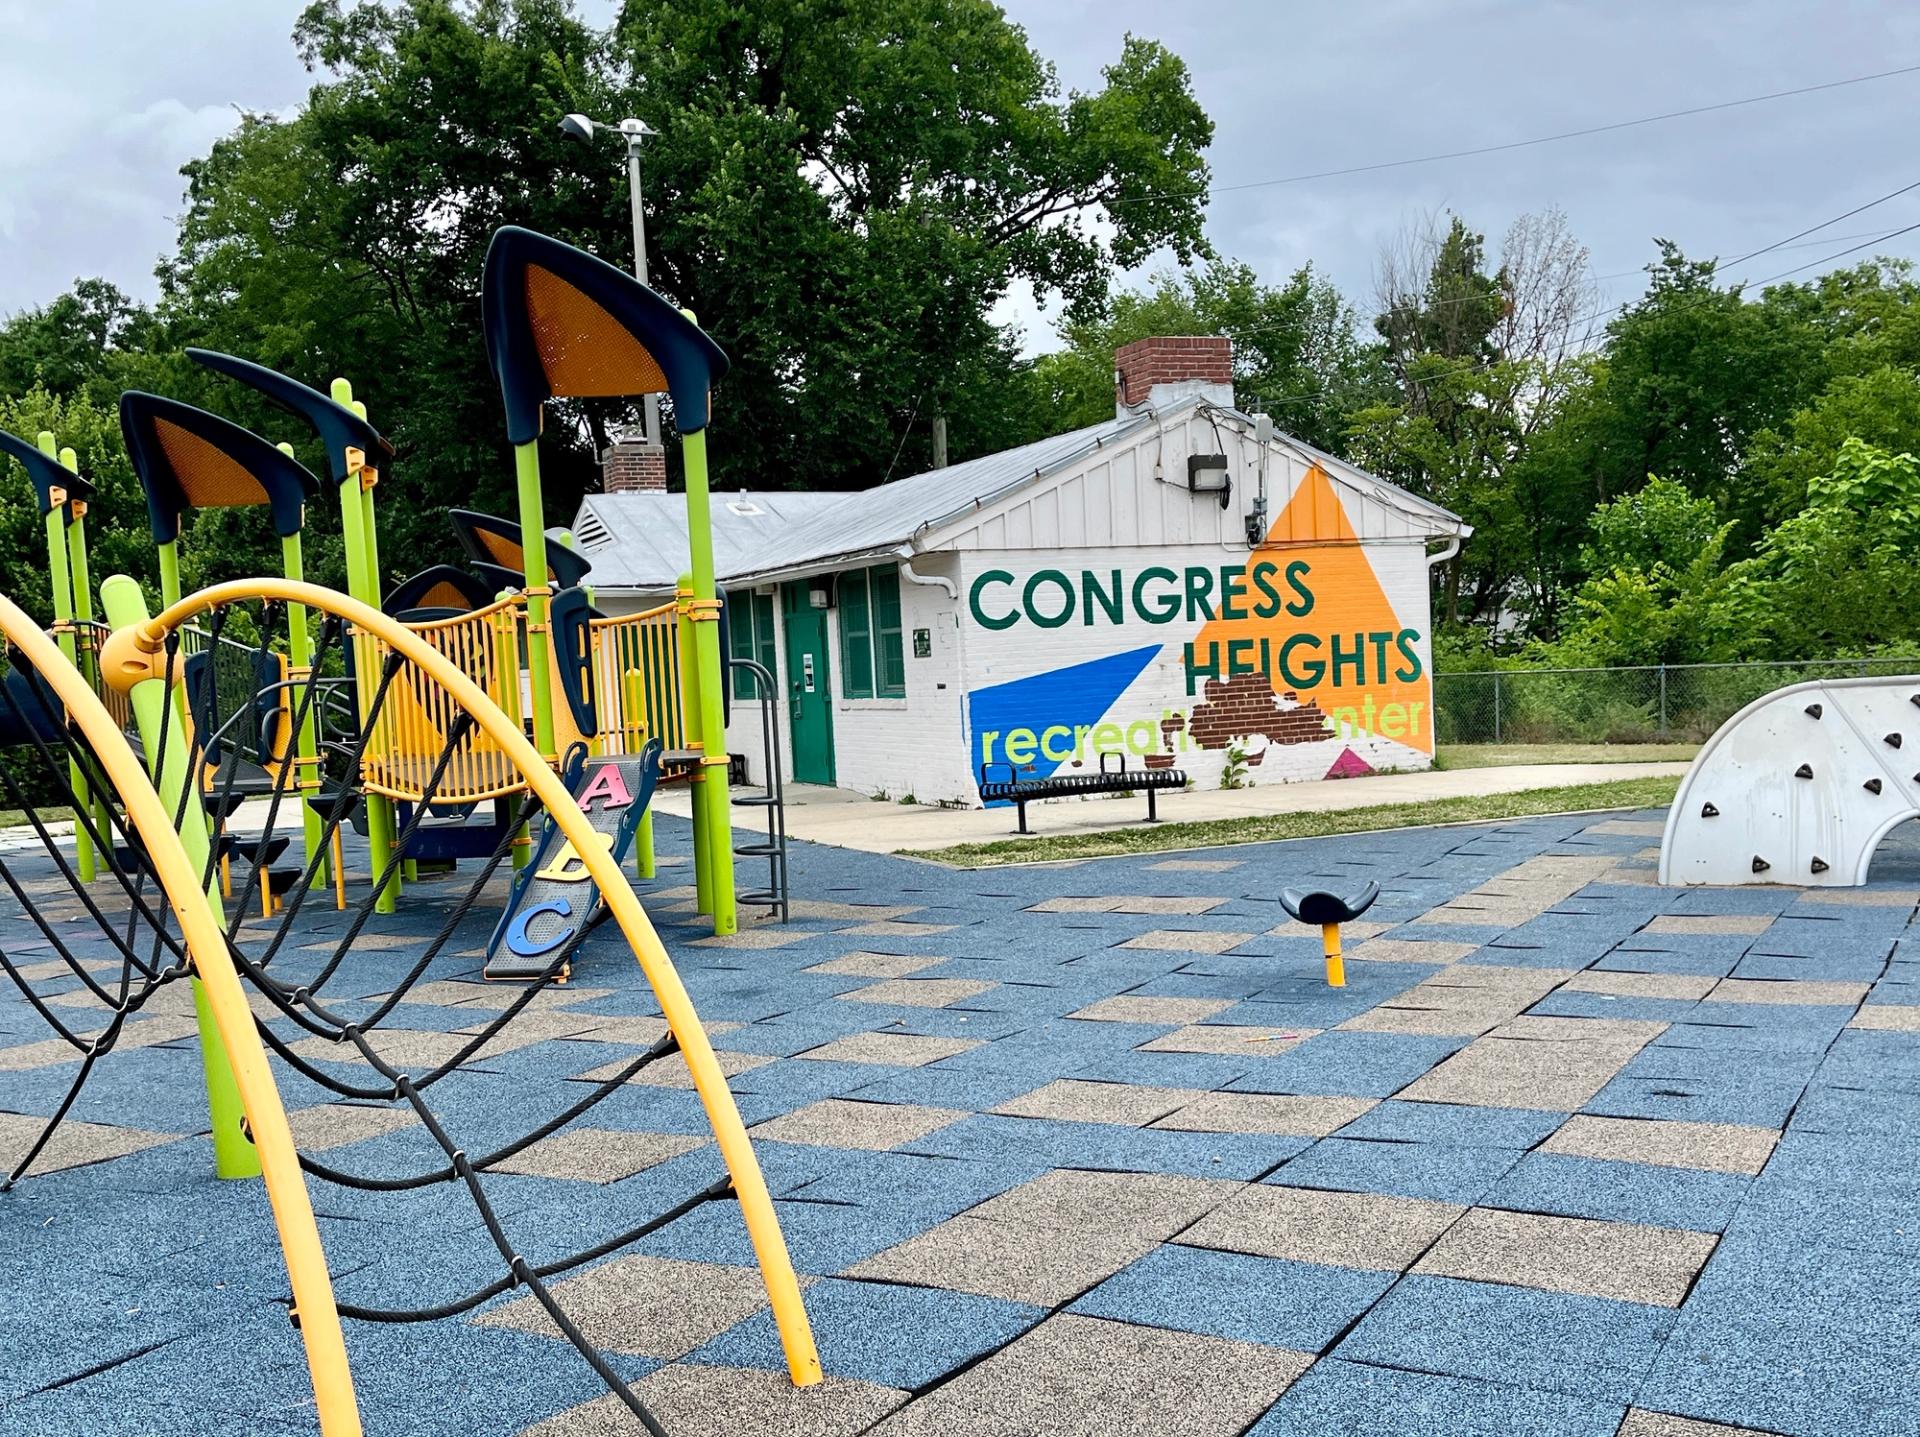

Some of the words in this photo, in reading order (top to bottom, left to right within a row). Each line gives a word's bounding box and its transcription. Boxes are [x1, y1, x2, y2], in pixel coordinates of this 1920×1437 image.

[969, 560, 1316, 631] CONGRESS
[1184, 628, 1422, 696] HEIGHTS
[1321, 693, 1425, 740] nter
